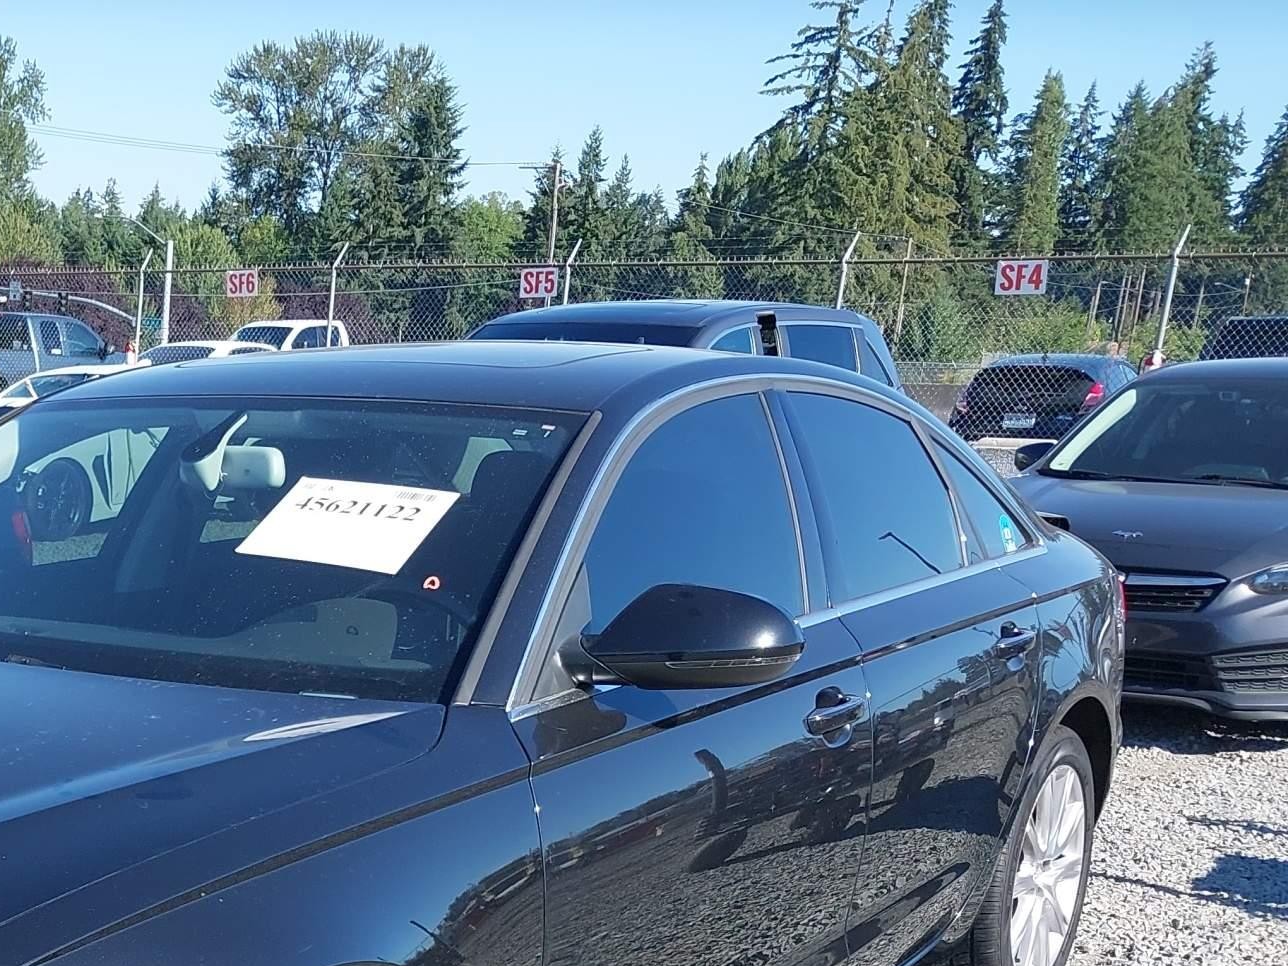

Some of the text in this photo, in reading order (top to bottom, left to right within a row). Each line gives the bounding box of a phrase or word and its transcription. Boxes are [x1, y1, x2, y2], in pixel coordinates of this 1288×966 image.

[229, 272, 255, 294] SF6
[523, 271, 554, 294] SF5
[1000, 263, 1043, 291] SF4
[295, 496, 422, 522] 45621122
